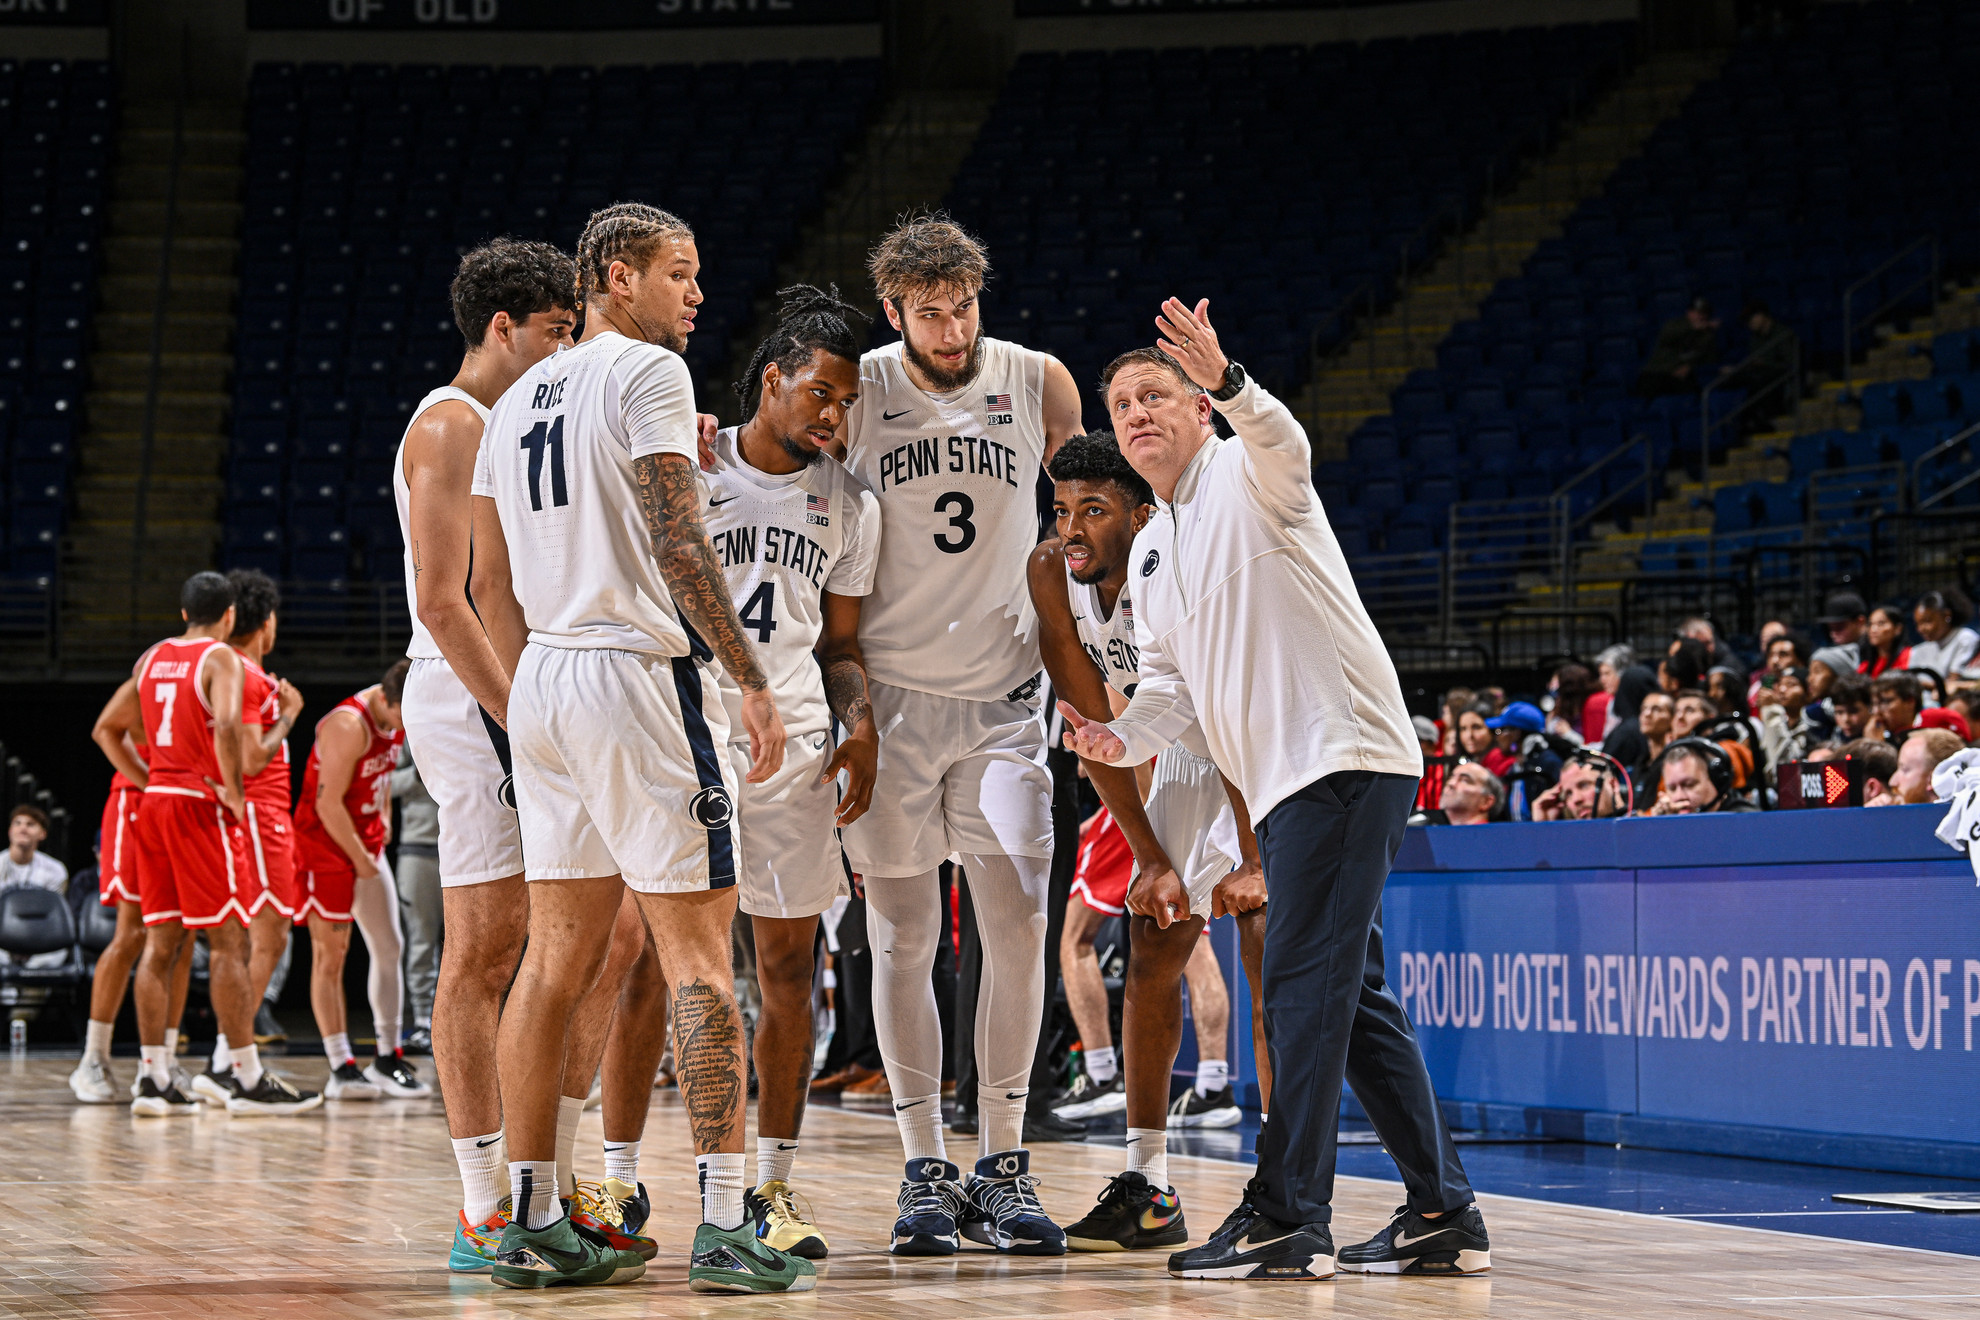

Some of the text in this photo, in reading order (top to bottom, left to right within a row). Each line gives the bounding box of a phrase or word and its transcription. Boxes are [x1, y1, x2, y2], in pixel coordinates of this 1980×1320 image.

[531, 376, 568, 409] RICE
[520, 414, 569, 511] 11
[880, 436, 1018, 493] PENN STATE
[933, 491, 977, 554] 3
[712, 526, 829, 590] ENN STATE
[738, 581, 778, 643] 4
[155, 682, 177, 747] 7
[1400, 951, 1486, 1029] PROUD
[1493, 952, 1578, 1033] HOTEL
[1584, 954, 1731, 1042] REWARDS
[1741, 957, 1893, 1048] PARTNER
[1903, 957, 1952, 1051] OF
